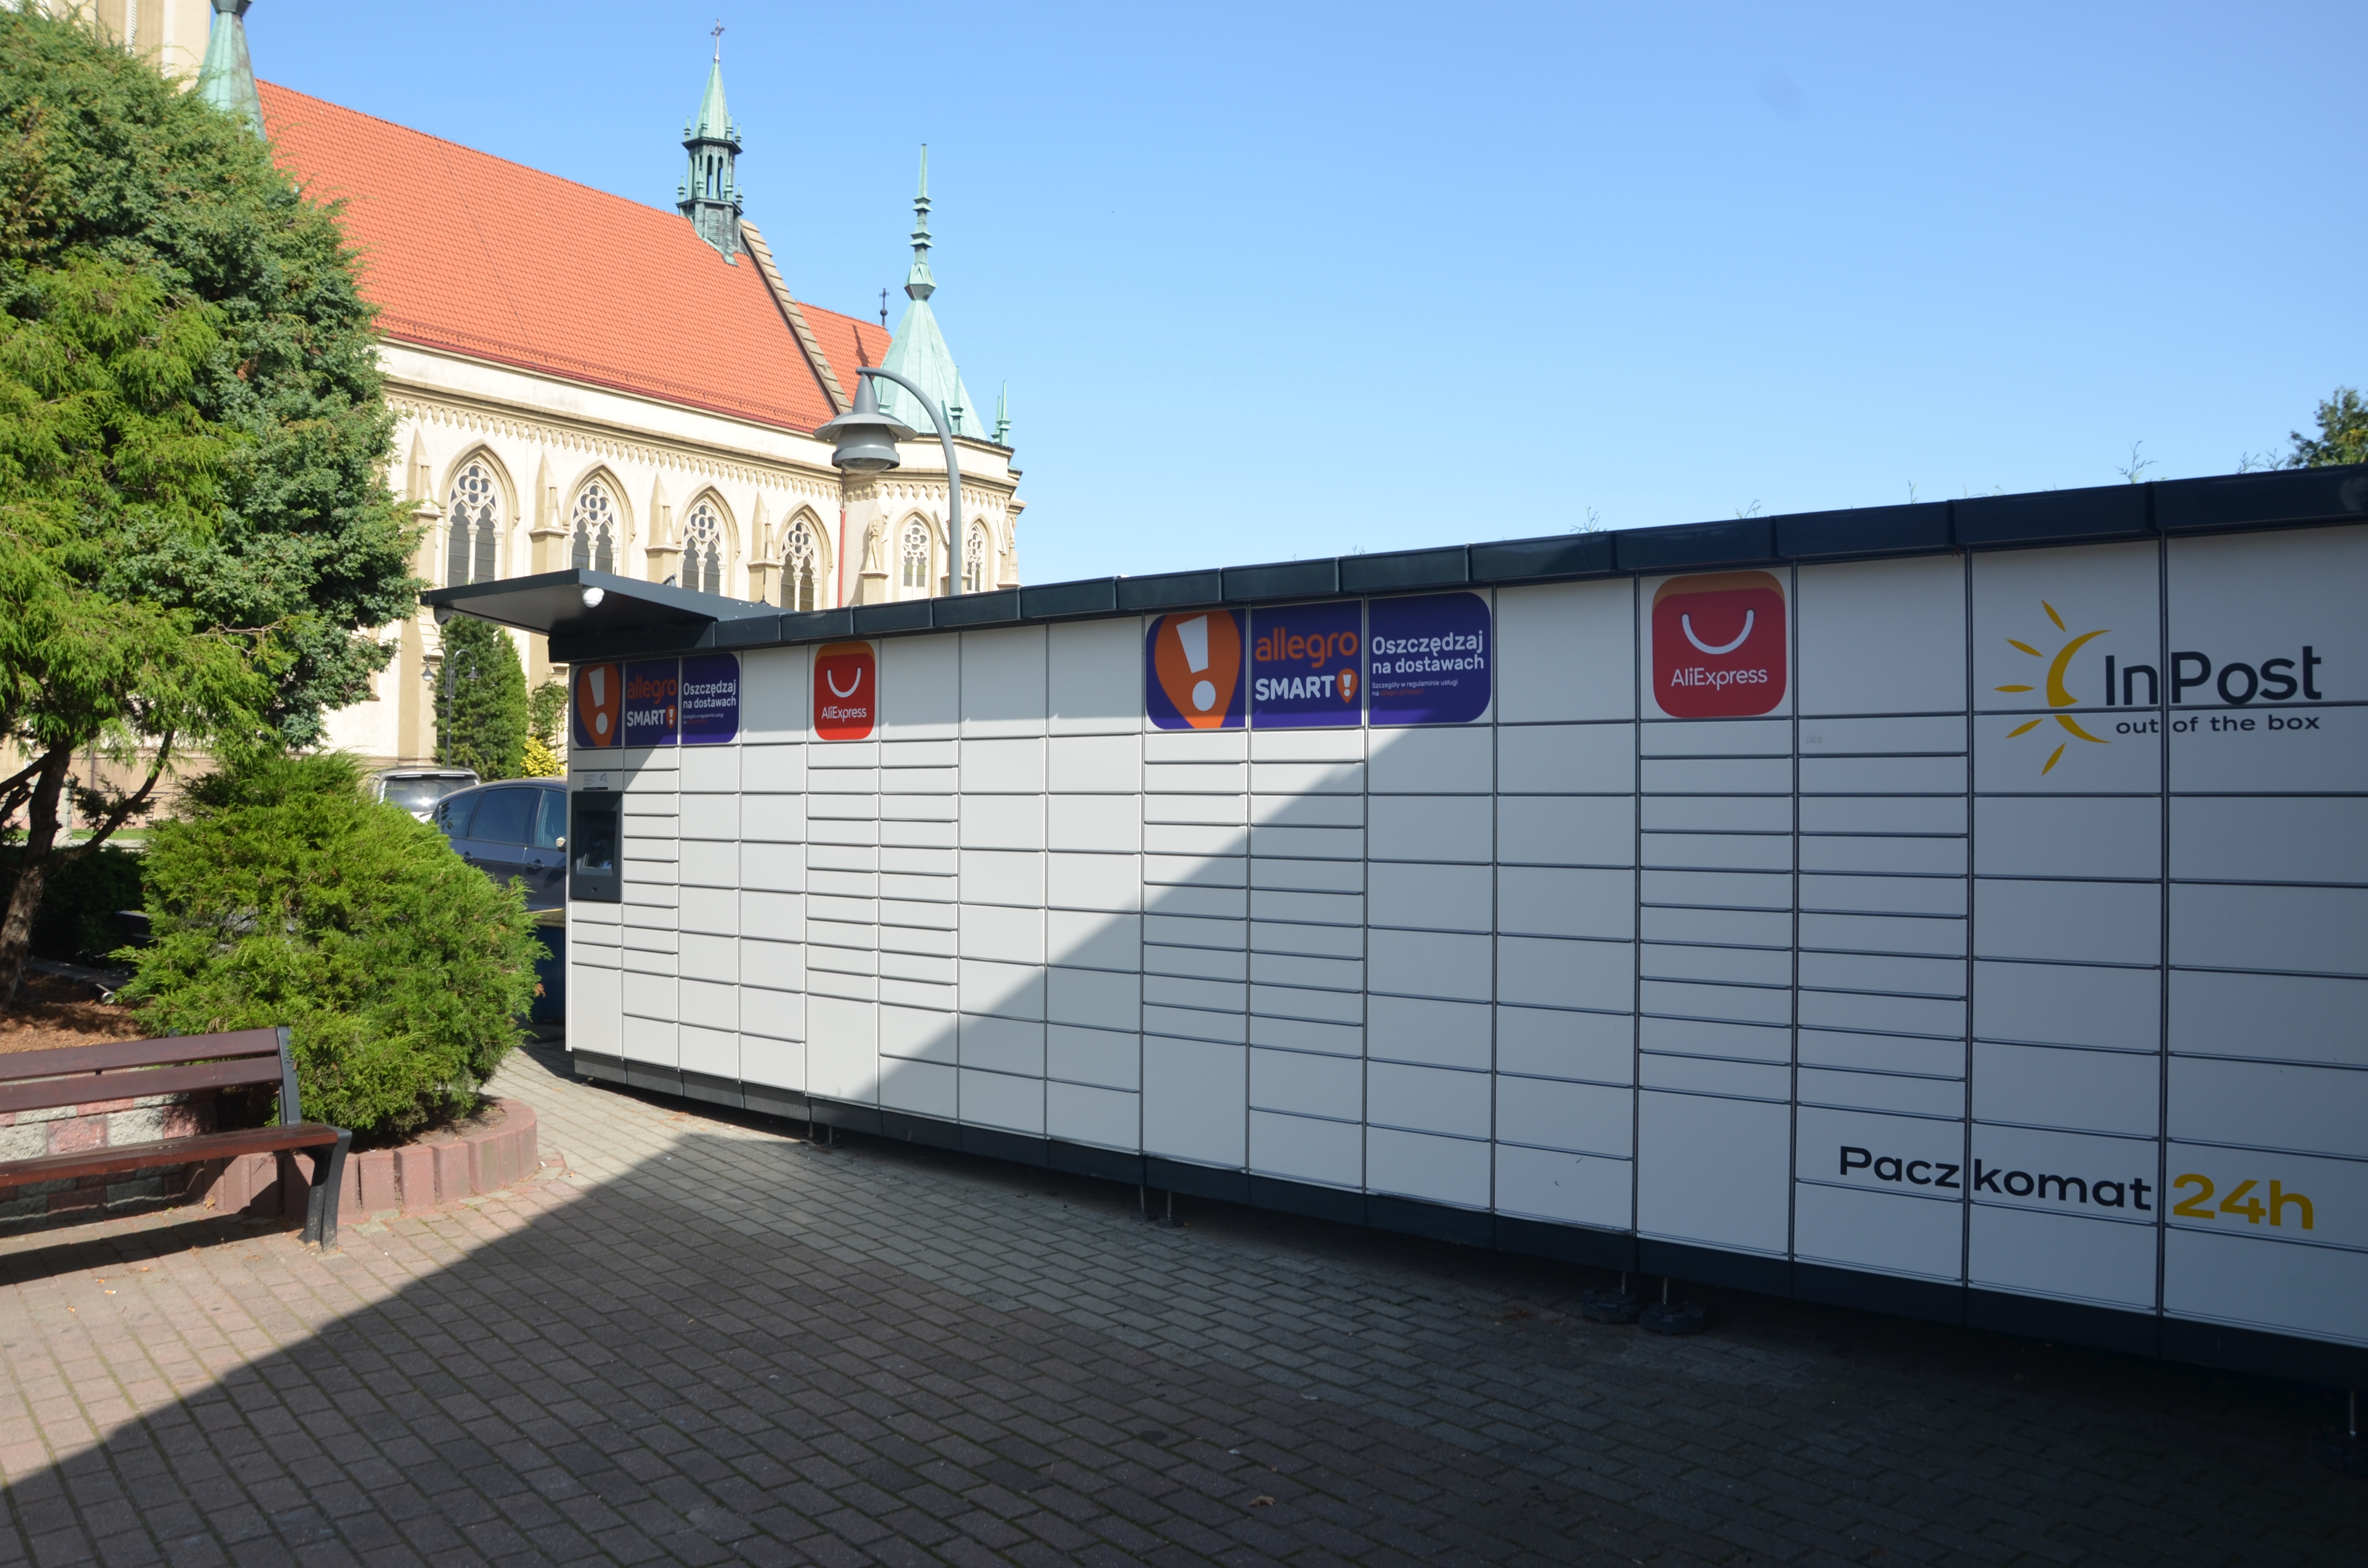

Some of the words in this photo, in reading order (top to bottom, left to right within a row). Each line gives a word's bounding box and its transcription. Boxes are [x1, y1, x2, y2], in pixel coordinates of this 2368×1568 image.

[1255, 627, 1358, 668] allegro
[1372, 630, 1483, 656] Oszczędzaj
[1372, 662, 1391, 674] na
[1395, 654, 1484, 673] dostawach
[1407, 680, 1440, 688] regulaminie
[1441, 679, 1458, 687] usługi
[1671, 667, 1768, 690] AliExpress
[2105, 646, 2322, 706] InPost
[627, 675, 677, 704] allegro
[683, 679, 736, 697] Oszczędzaj
[683, 700, 692, 709] na
[694, 696, 736, 708] dostawach
[821, 706, 867, 723] AliExpress
[2116, 719, 2159, 734] out
[2172, 717, 2198, 732] of
[2210, 716, 2256, 731] the
[2268, 714, 2320, 730] box
[1839, 1145, 2152, 1210] Paczkomat
[2172, 1173, 2314, 1230] 24h
